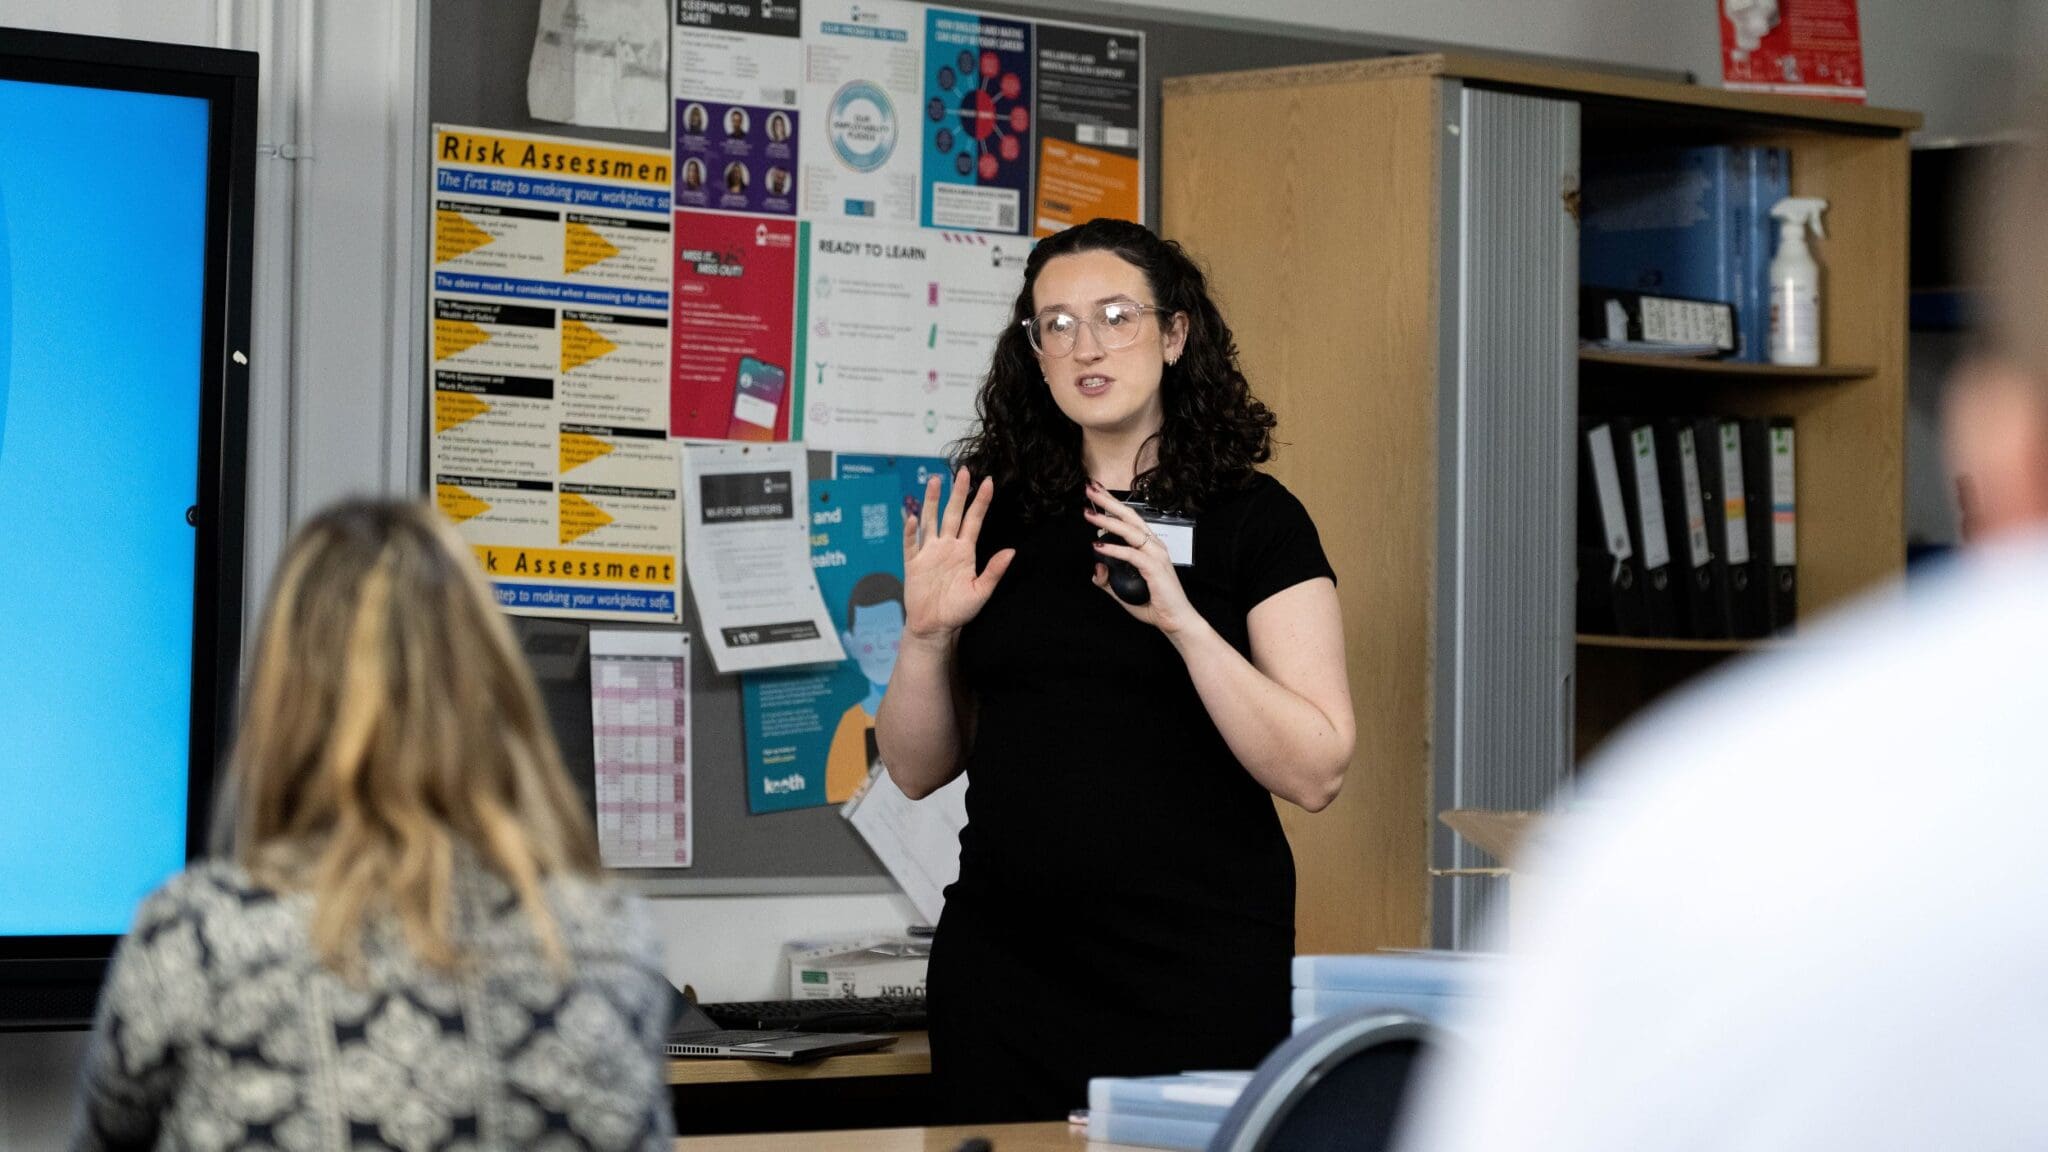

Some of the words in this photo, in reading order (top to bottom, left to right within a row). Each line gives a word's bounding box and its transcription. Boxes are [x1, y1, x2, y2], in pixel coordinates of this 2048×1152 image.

[728, 5, 750, 16] YOU
[443, 136, 505, 164] Risk
[521, 145, 668, 182] Assessmen
[439, 171, 460, 188] The
[463, 173, 489, 192] first
[491, 178, 514, 196] step
[518, 180, 531, 194] to
[532, 183, 571, 204] making
[573, 189, 598, 205] your
[601, 189, 654, 209] workplace
[819, 239, 859, 254] READY
[864, 243, 882, 256] TO
[886, 244, 927, 259] LEARN
[438, 276, 452, 288] The
[455, 279, 479, 290] above
[482, 282, 503, 291] must
[504, 281, 514, 292] be
[516, 282, 560, 297] considered
[562, 289, 583, 298] when
[622, 294, 636, 303] the
[745, 503, 784, 515] VISITORS
[814, 507, 842, 525] and
[515, 552, 671, 580] Assessment
[519, 590, 529, 602] to
[532, 590, 570, 608] making
[572, 594, 594, 608] your
[597, 594, 646, 611] workplace
[764, 773, 805, 795] kooth
